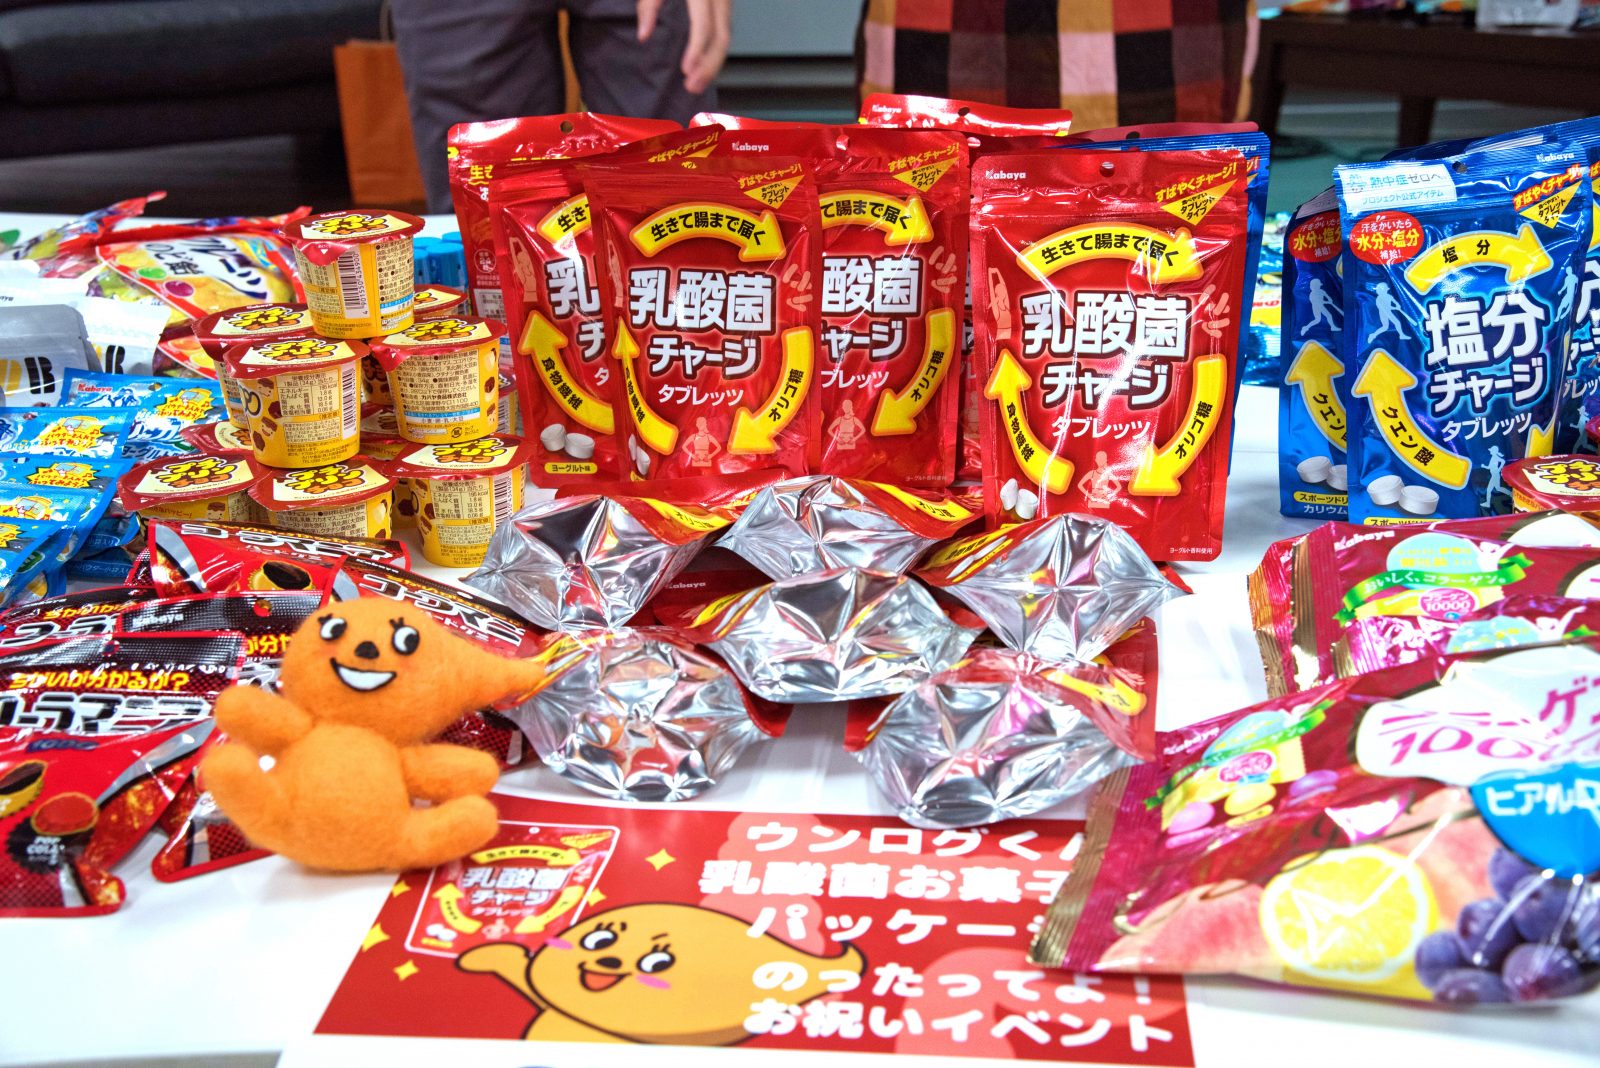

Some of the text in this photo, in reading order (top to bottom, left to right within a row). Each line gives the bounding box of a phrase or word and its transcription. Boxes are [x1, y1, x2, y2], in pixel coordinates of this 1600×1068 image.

[732, 142, 769, 152] Kabaya
[888, 142, 960, 172] すばやくチャージ!
[737, 162, 802, 188] すばやくチャージ!
[911, 168, 942, 183] タブレット
[917, 177, 935, 188] タイプ
[986, 169, 1026, 181] Kabaya
[1155, 161, 1237, 203] すばやくチャージ!
[1370, 172, 1442, 188] 熱中症ゼロへ
[761, 186, 790, 200] タブレット
[767, 194, 784, 205] タイプ
[1180, 195, 1216, 215] タブレット
[1538, 198, 1567, 218] タブレット
[557, 203, 589, 232] 生き
[650, 211, 766, 245] 生きて腸まで届く
[1186, 206, 1208, 221] タイプ
[1361, 219, 1412, 233] 汗をかいたら
[1041, 233, 1179, 267] 生きて腸まで届く
[1357, 228, 1420, 252] 水分+塩分
[1380, 249, 1401, 261] 補給!
[629, 268, 772, 331] 乳酸菌
[821, 257, 920, 314] 酸菌
[1022, 292, 1187, 357] 乳酸菌
[1426, 292, 1545, 366] 塩分
[821, 320, 903, 360] ャージ
[649, 337, 756, 376] チャージ
[77, 382, 112, 394] Kabaya
[541, 357, 583, 411] 食物繊維
[911, 350, 945, 402] オリゴ糖
[1043, 364, 1169, 406] チャージ
[1430, 357, 1543, 413] チャージ
[658, 384, 744, 406] タブレッツ
[768, 367, 805, 422] オリゴ糖
[1006, 402, 1036, 463] 食物繊維
[1051, 416, 1151, 440] タブレッツ
[1175, 401, 1213, 460] オリゴ糖
[1382, 406, 1435, 467] クエン酸
[1442, 412, 1532, 442] タブレッツ
[1334, 530, 1395, 551] Kabaya
[462, 867, 569, 891] 乳酸菌
[746, 903, 1045, 946] パッケー
[743, 998, 1174, 1052] お祝いイベント
